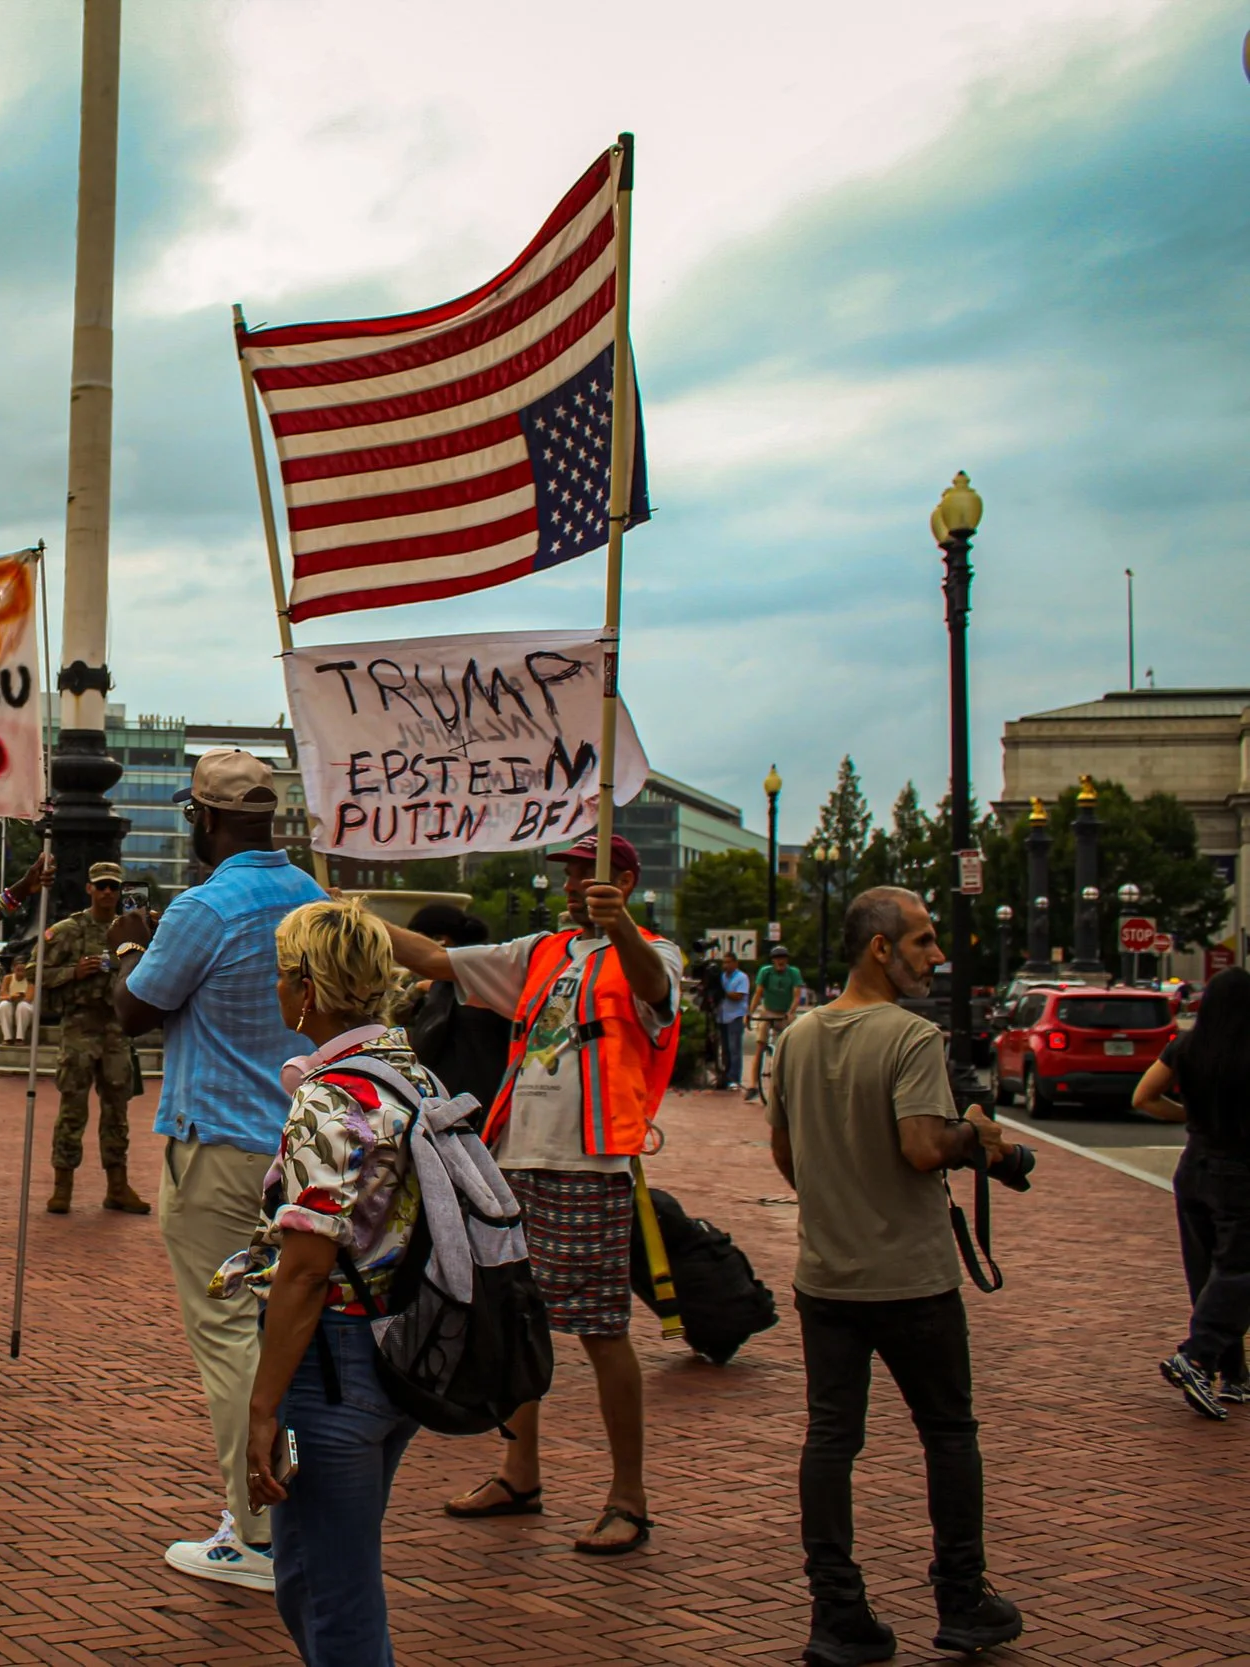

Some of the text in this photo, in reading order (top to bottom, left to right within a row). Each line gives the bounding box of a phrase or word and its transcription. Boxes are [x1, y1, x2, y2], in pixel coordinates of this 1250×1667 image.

[315, 651, 582, 733] TRUMP
[348, 737, 598, 799] EPSTEIN
[331, 801, 488, 848] PUTIN
[1121, 927, 1153, 942] STOP
